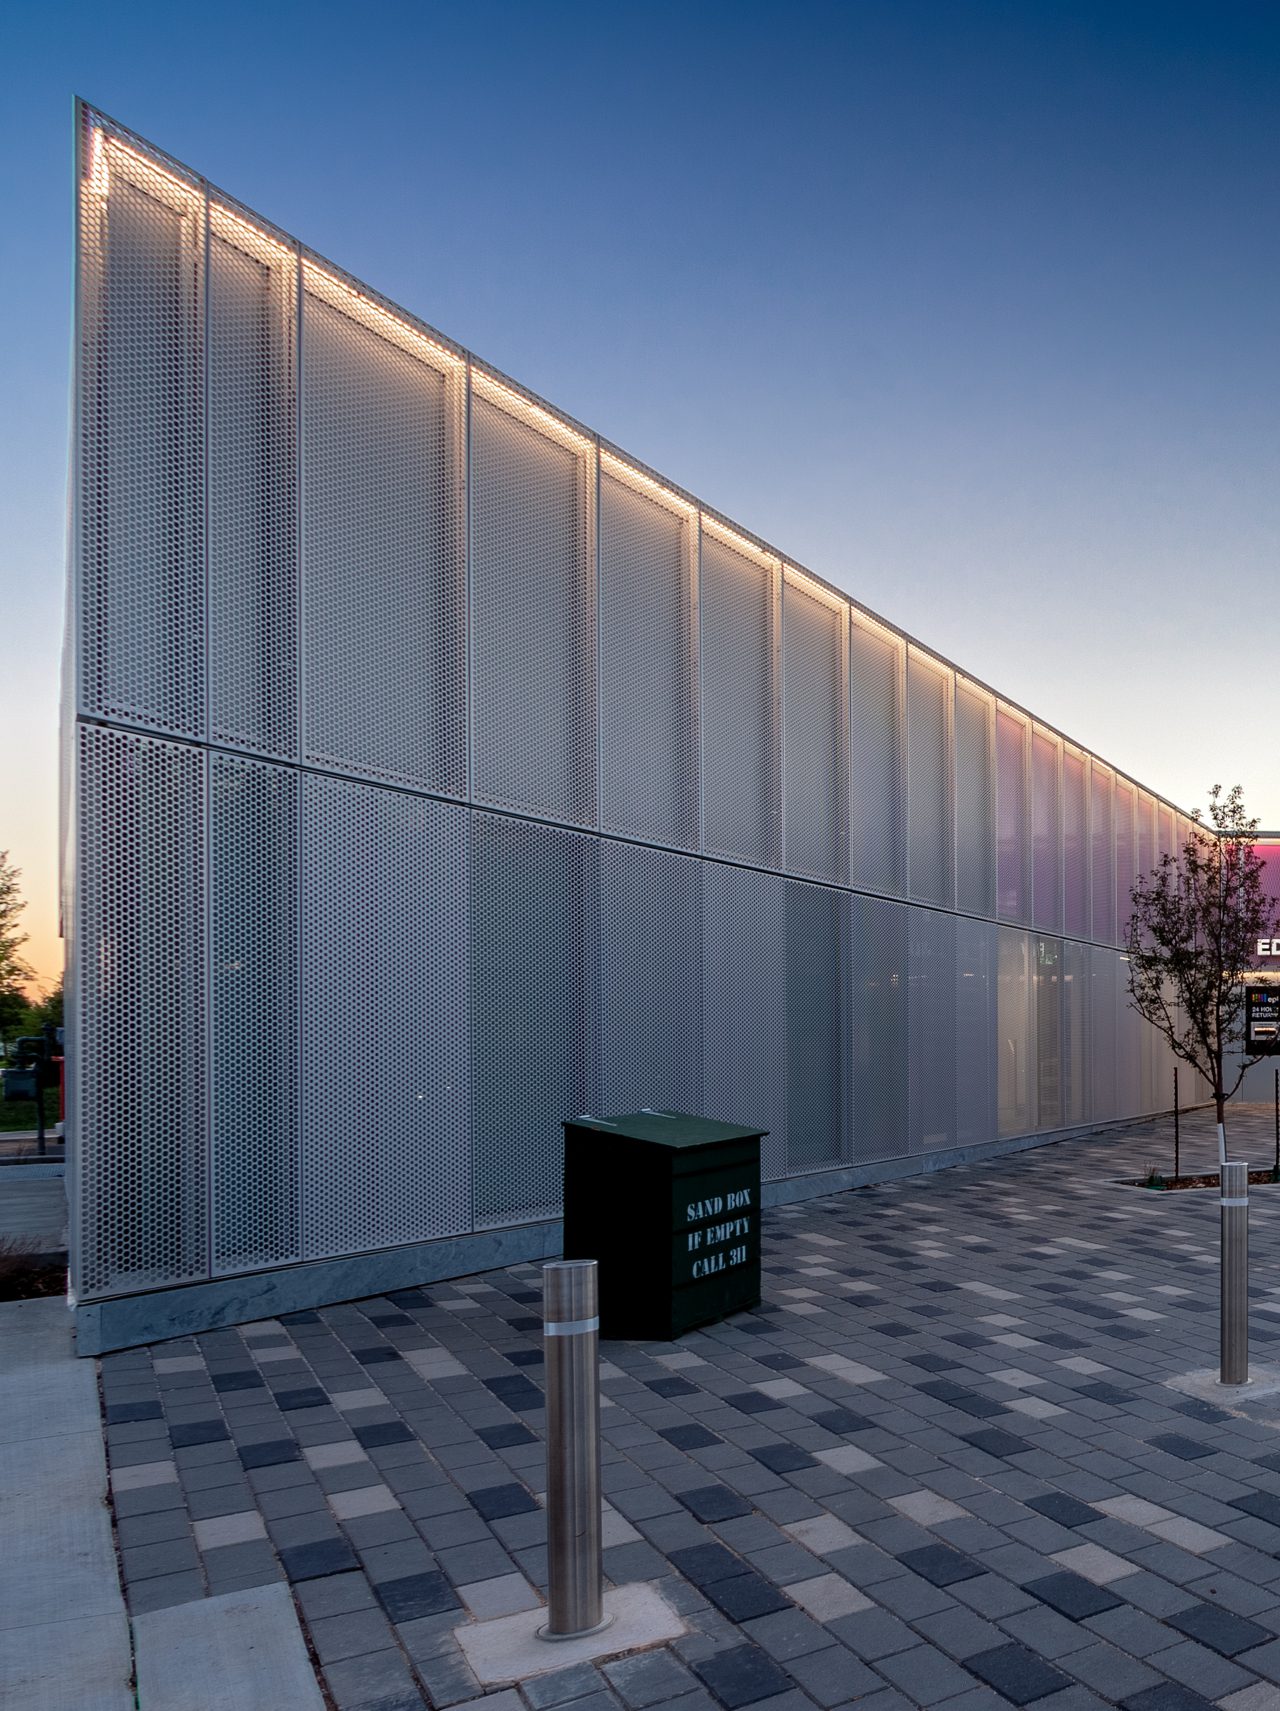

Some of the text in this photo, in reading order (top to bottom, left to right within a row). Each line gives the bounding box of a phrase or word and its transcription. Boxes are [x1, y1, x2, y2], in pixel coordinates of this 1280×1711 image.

[687, 1188, 751, 1222] SAND BOX
[688, 1216, 750, 1252] IF EMPTY
[692, 1245, 746, 1279] CALL 311
